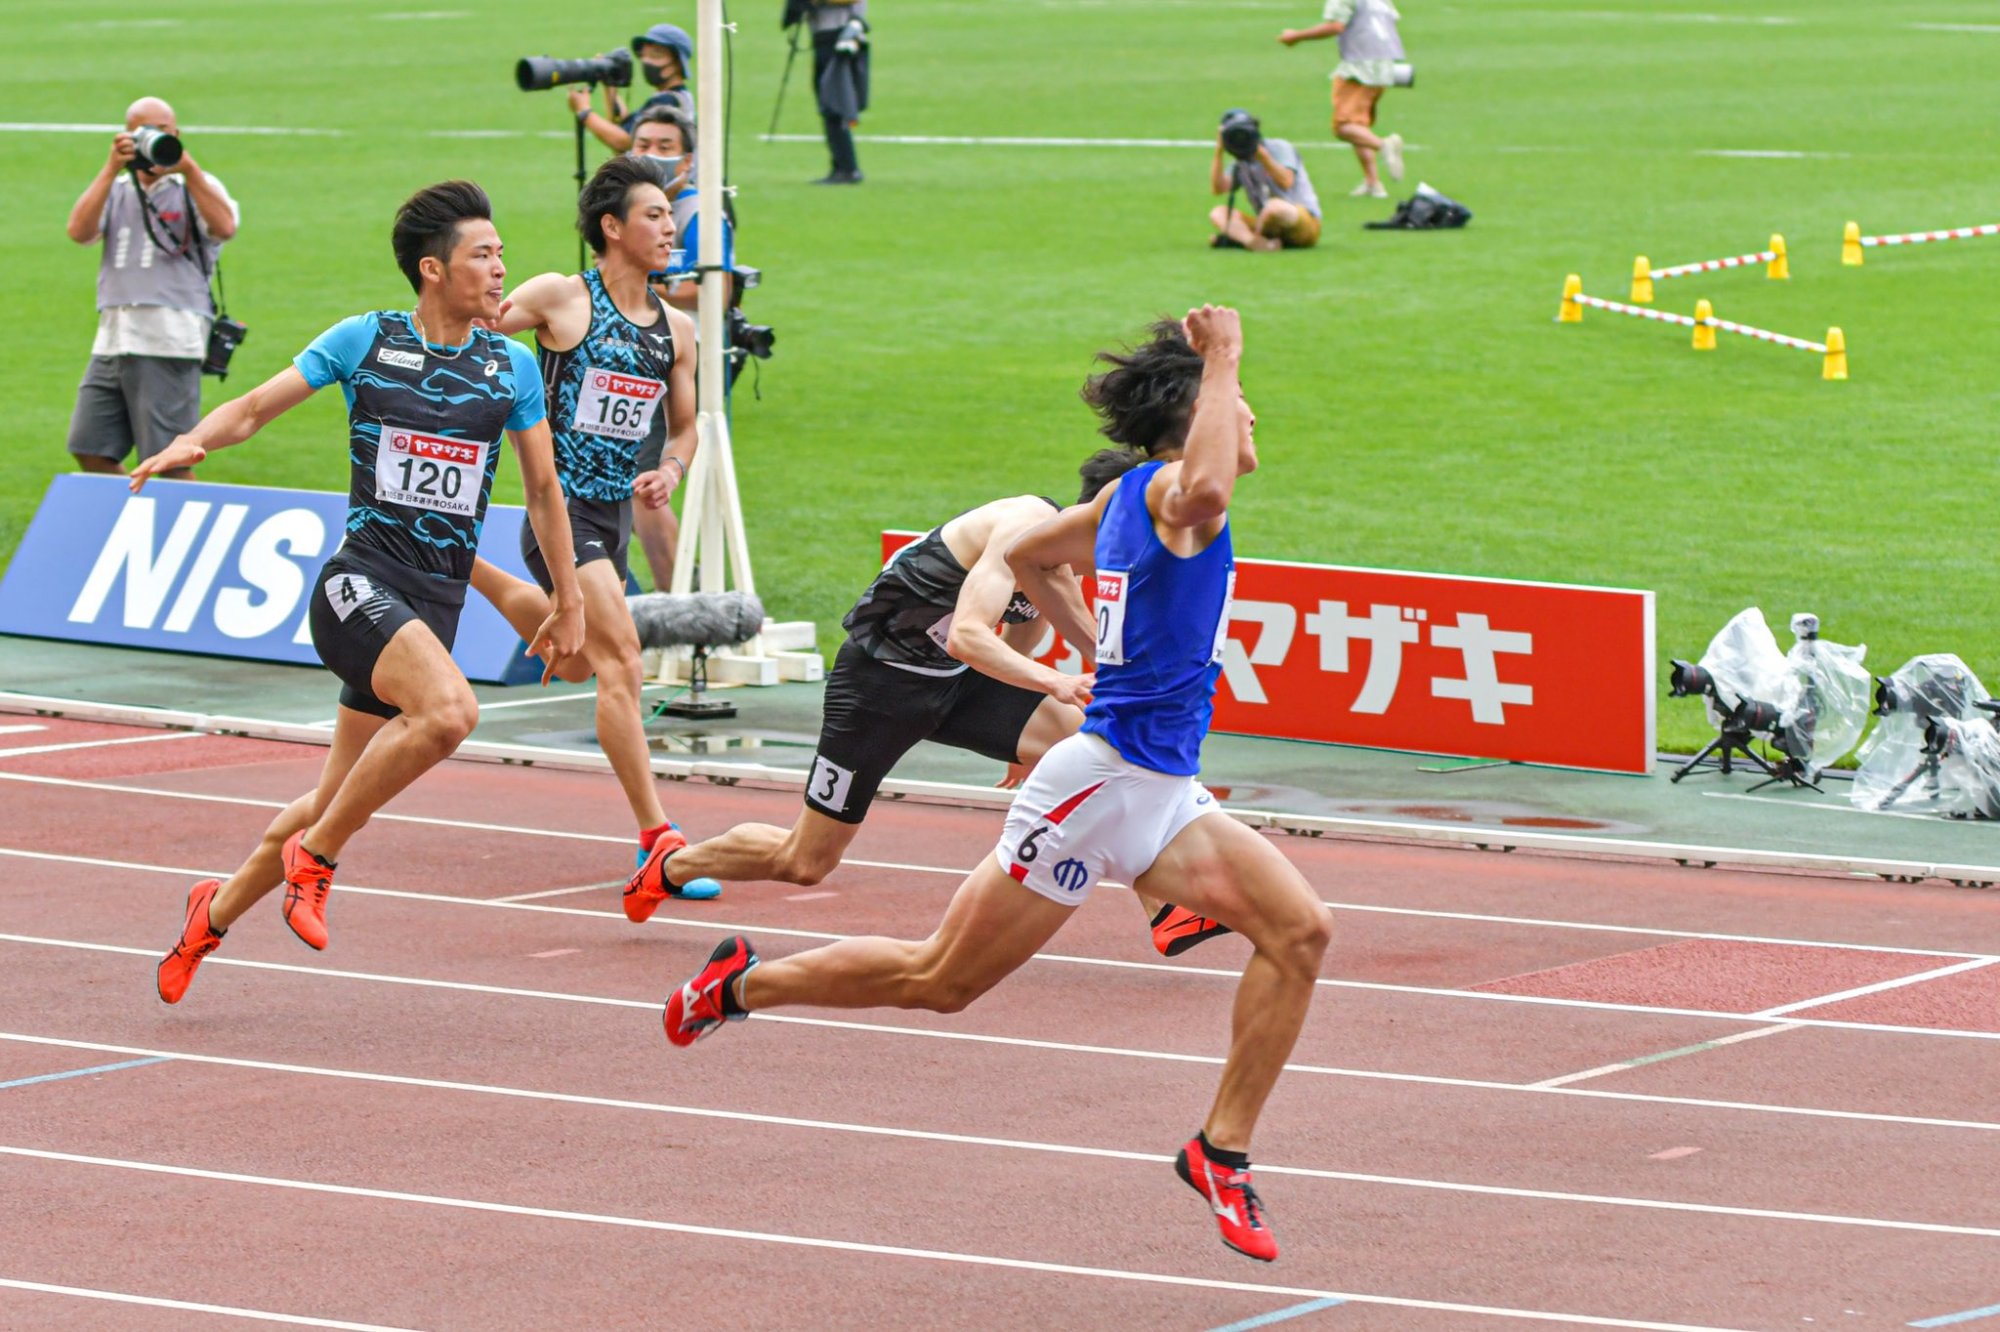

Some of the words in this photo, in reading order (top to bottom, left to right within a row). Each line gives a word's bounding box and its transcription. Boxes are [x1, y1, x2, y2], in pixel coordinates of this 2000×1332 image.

[379, 350, 422, 369] Ehime
[612, 378, 657, 397] ヤマザキ
[597, 395, 647, 429] 165
[414, 439, 476, 461] ヤマザキ
[397, 458, 462, 499] 120
[67, 496, 346, 644] NIS
[341, 576, 358, 604] 4
[817, 767, 840, 802] 3
[1017, 826, 1049, 863] 6
